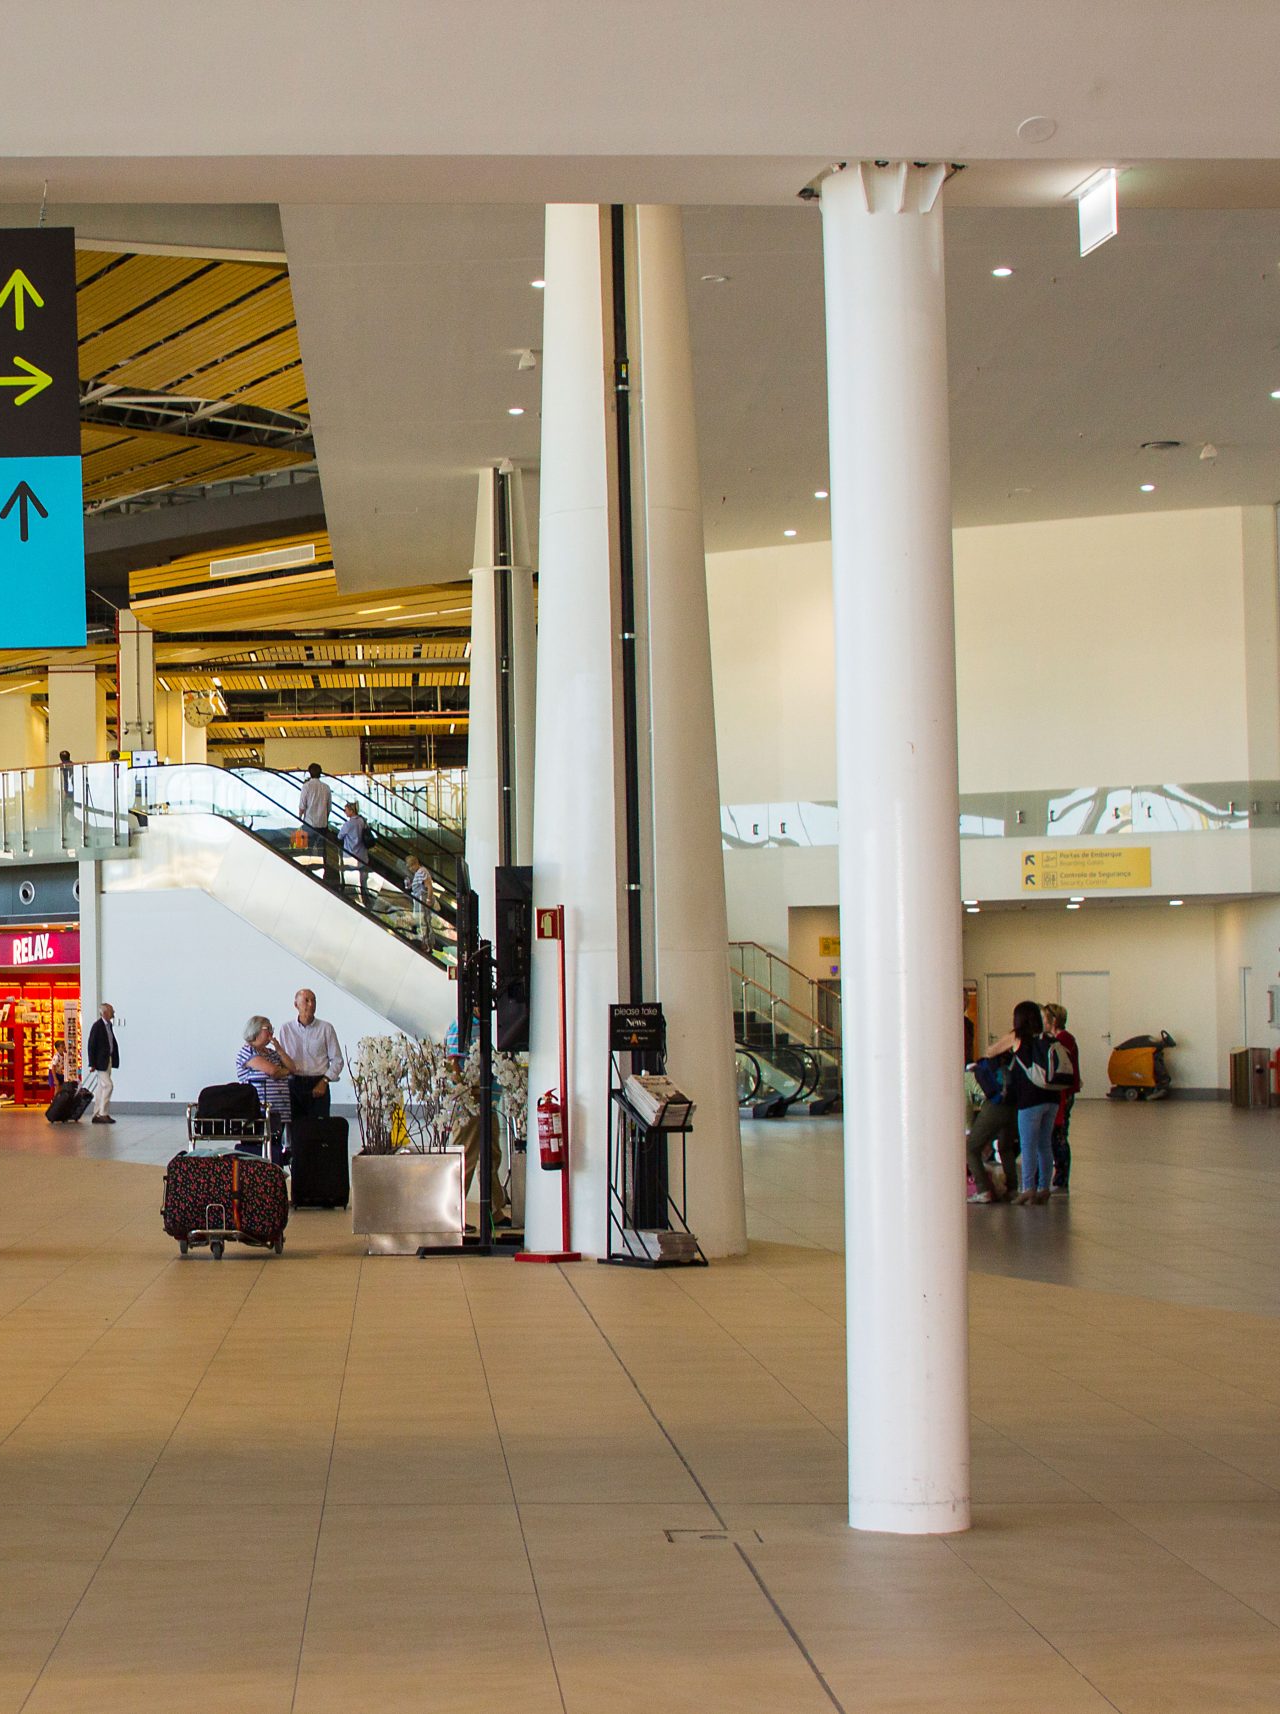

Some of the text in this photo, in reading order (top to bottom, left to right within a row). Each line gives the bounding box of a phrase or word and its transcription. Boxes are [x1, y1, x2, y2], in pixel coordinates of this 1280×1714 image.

[614, 1006, 658, 1018] please take
[625, 1018, 647, 1027] News
